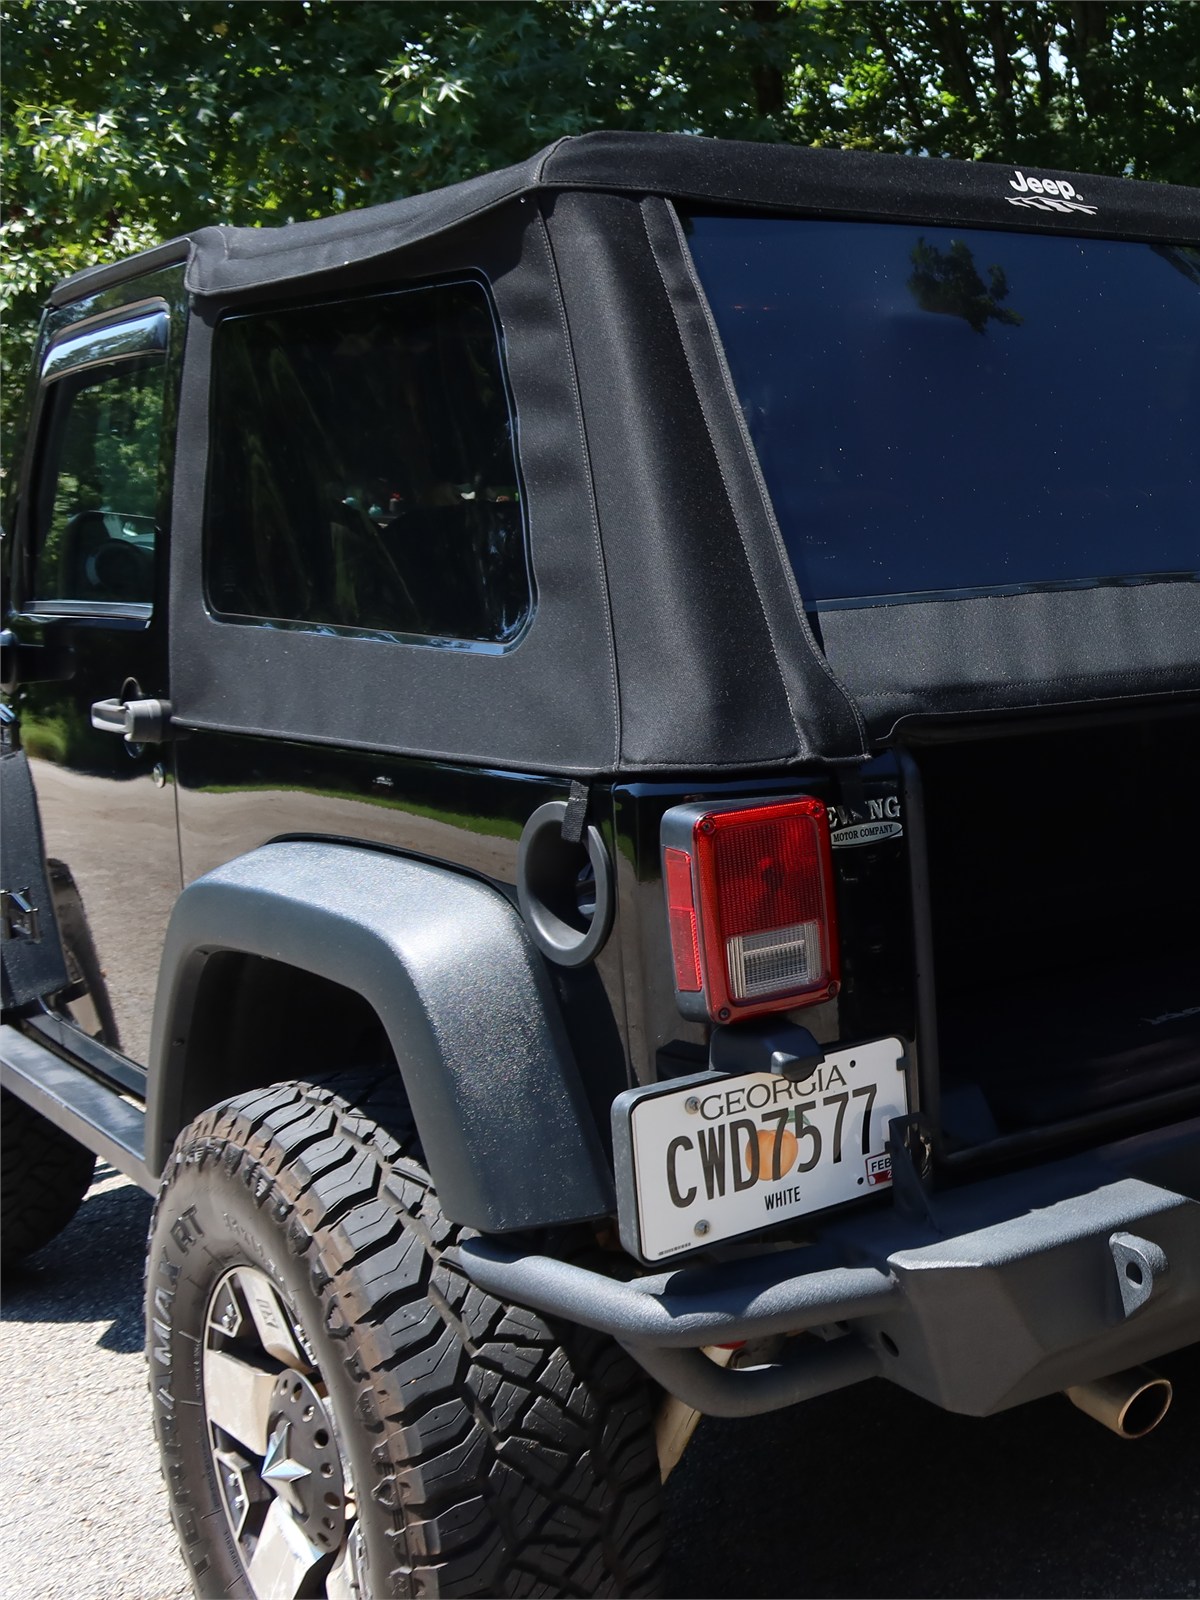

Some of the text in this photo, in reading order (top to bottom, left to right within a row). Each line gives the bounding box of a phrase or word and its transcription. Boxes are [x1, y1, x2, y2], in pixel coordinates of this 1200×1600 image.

[1009, 170, 1076, 200] Jeep
[833, 824, 894, 842] MOTOR COMPANY
[699, 1064, 847, 1121] GEORGIA
[666, 1083, 877, 1208] CWD7577
[871, 1157, 892, 1172] FEB
[764, 1186, 801, 1211] WHITE
